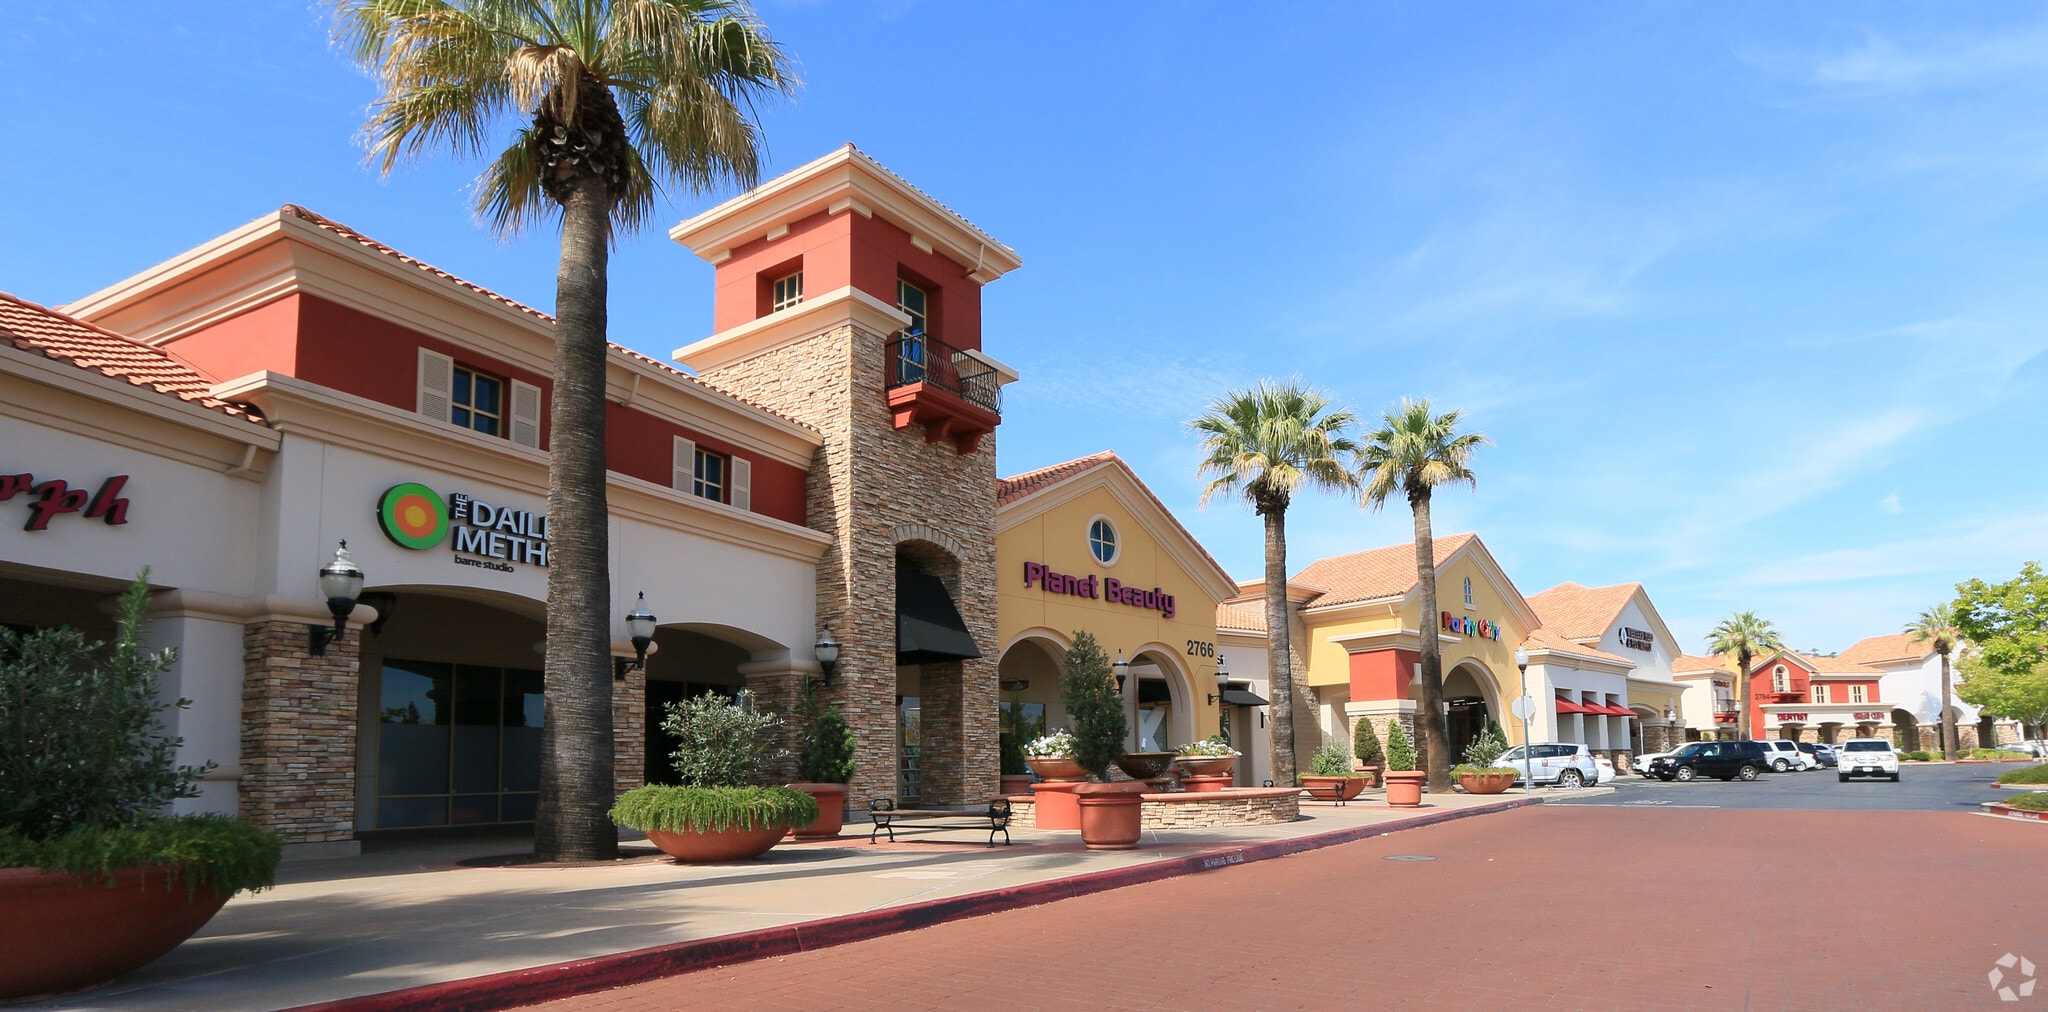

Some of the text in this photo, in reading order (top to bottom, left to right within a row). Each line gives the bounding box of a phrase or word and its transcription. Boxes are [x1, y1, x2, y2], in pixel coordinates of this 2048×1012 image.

[451, 493, 468, 519] THE
[454, 525, 549, 566] METH
[454, 554, 514, 573] barre studio
[1024, 561, 1175, 618] Planet Beauty
[1441, 611, 1501, 642] Party City
[1187, 639, 1214, 658] 2766
[1777, 713, 1808, 722] DENTIST
